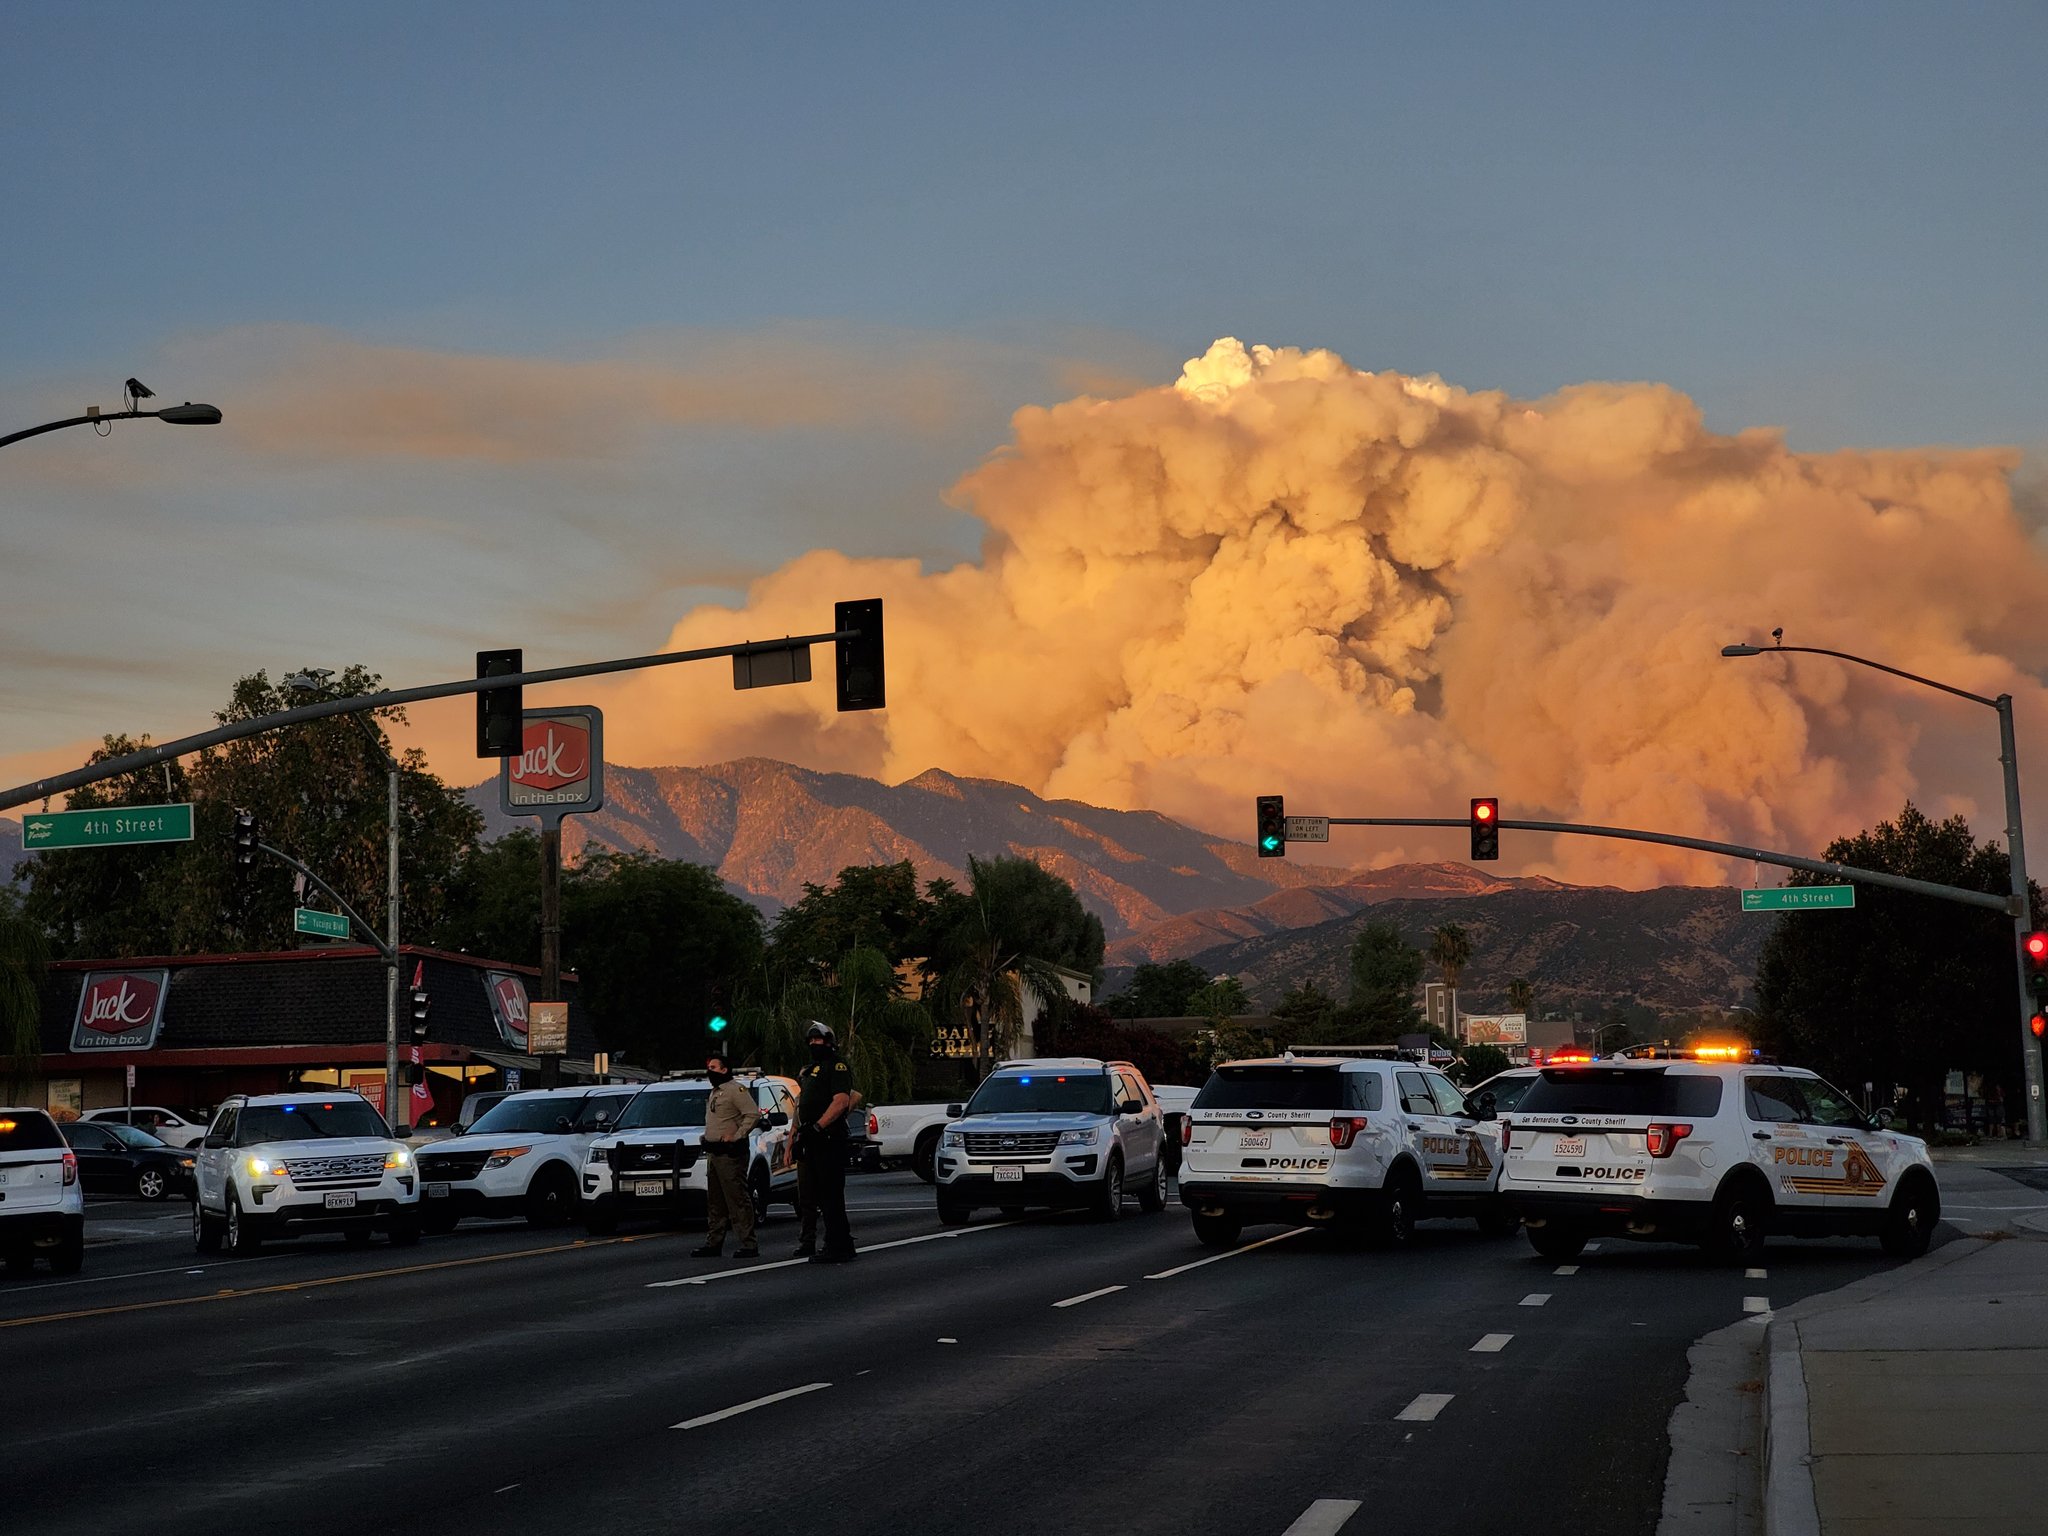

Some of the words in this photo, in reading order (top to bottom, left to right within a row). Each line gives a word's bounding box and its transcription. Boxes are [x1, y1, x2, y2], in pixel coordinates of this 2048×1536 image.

[512, 729, 584, 779] Jack
[515, 793, 528, 804] in
[531, 792, 554, 803] the
[557, 791, 583, 803] box
[84, 821, 109, 835] 4th
[116, 817, 163, 833] Street
[1781, 894, 1799, 903] 4th
[1802, 893, 1834, 903] Street
[84, 980, 151, 1024] Jack
[81, 1035, 93, 1046] in
[96, 1035, 116, 1045] the
[119, 1035, 143, 1045] box
[930, 1039, 993, 1053] GRI
[1214, 1111, 1243, 1119] Bernardino
[1267, 1111, 1287, 1119] County
[1290, 1111, 1311, 1119] Sheriff
[1532, 1116, 1559, 1124] Bernardino
[1581, 1117, 1601, 1126] County
[1604, 1117, 1626, 1125] Sheriff
[1239, 1137, 1269, 1147] 1500467
[1422, 1136, 1460, 1155] POLICE
[1554, 1144, 1583, 1154] 1524590
[1775, 1147, 1834, 1167] POLICE
[1268, 1158, 1330, 1170] POLICE
[1582, 1167, 1646, 1180] POLICE
